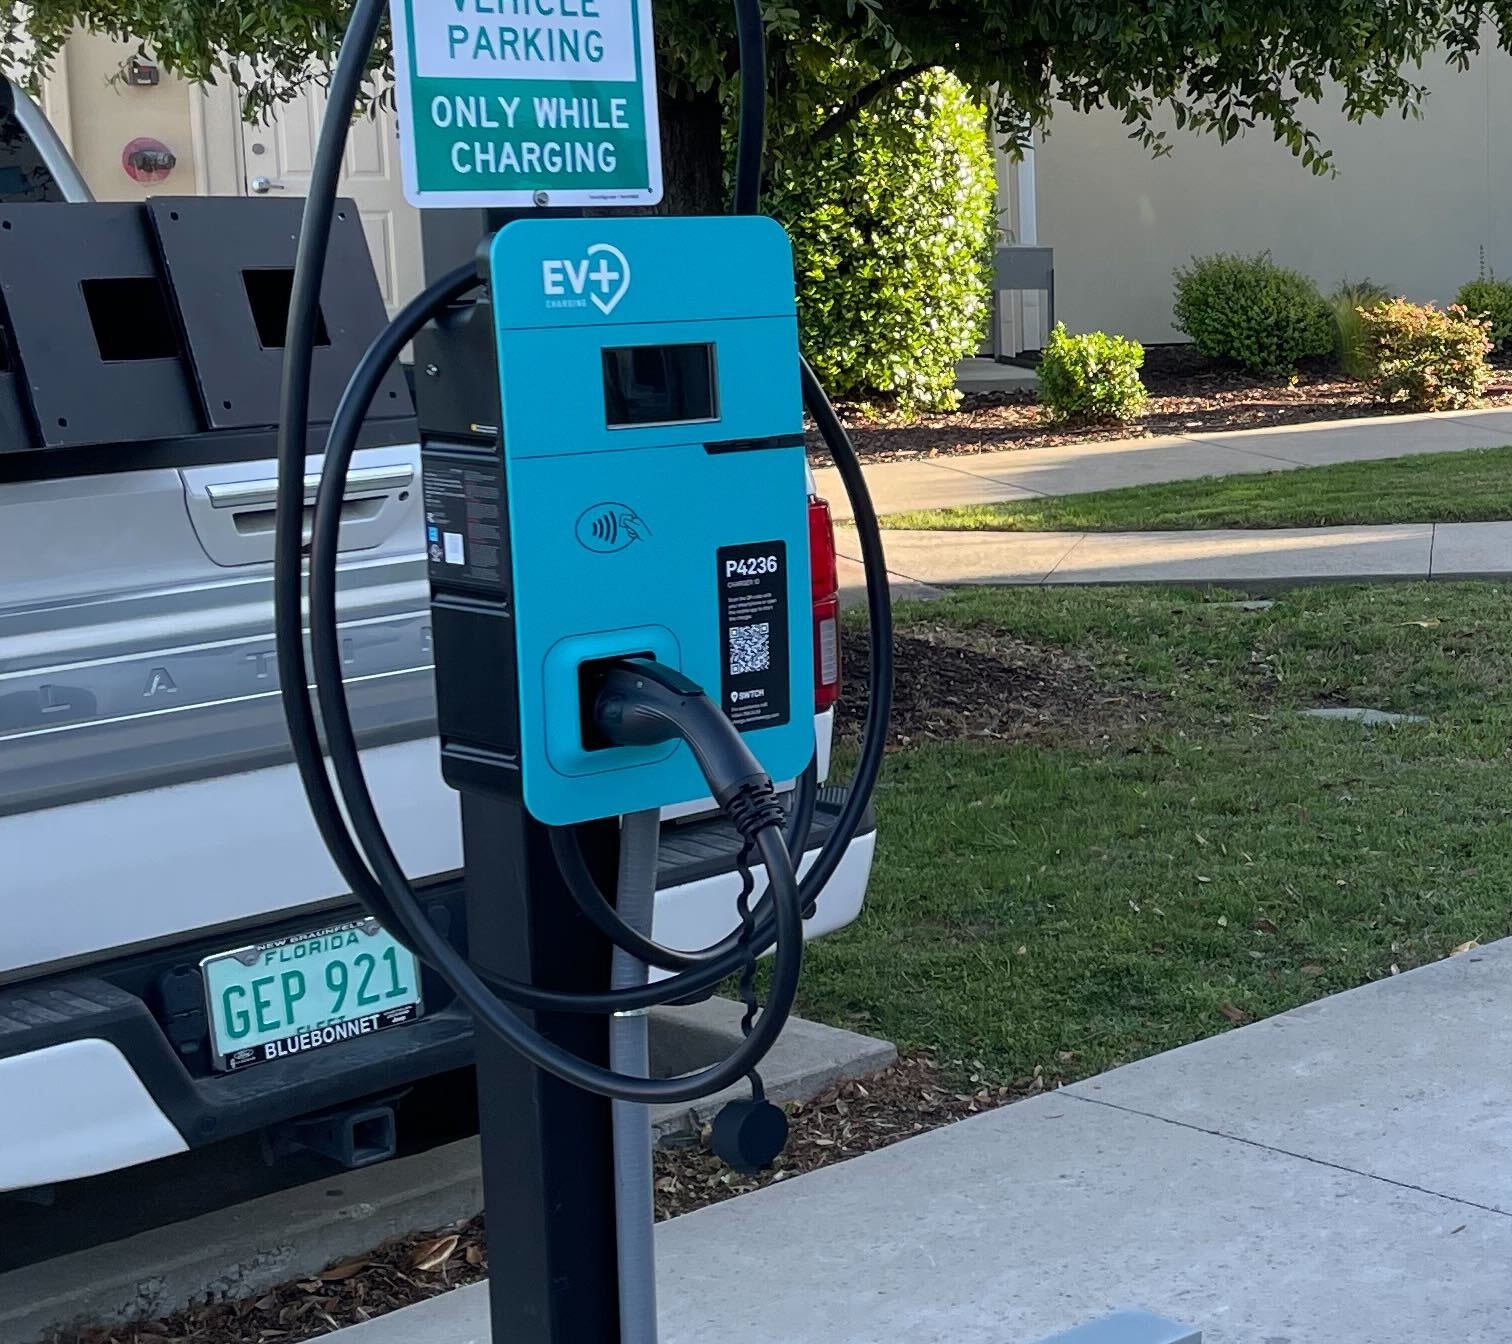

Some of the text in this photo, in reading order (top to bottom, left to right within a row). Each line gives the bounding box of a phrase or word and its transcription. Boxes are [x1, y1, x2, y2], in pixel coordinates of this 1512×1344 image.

[448, 25, 604, 63] PARKING
[431, 95, 630, 129] ONLY WHILE
[450, 141, 617, 174] CHARGING
[726, 556, 778, 577] P4236
[256, 921, 365, 952] NEW BRAUNFELS
[265, 932, 360, 967] FLORIDA
[222, 946, 408, 1039] GEP 921
[264, 1014, 382, 1060] BLUEBONNET
